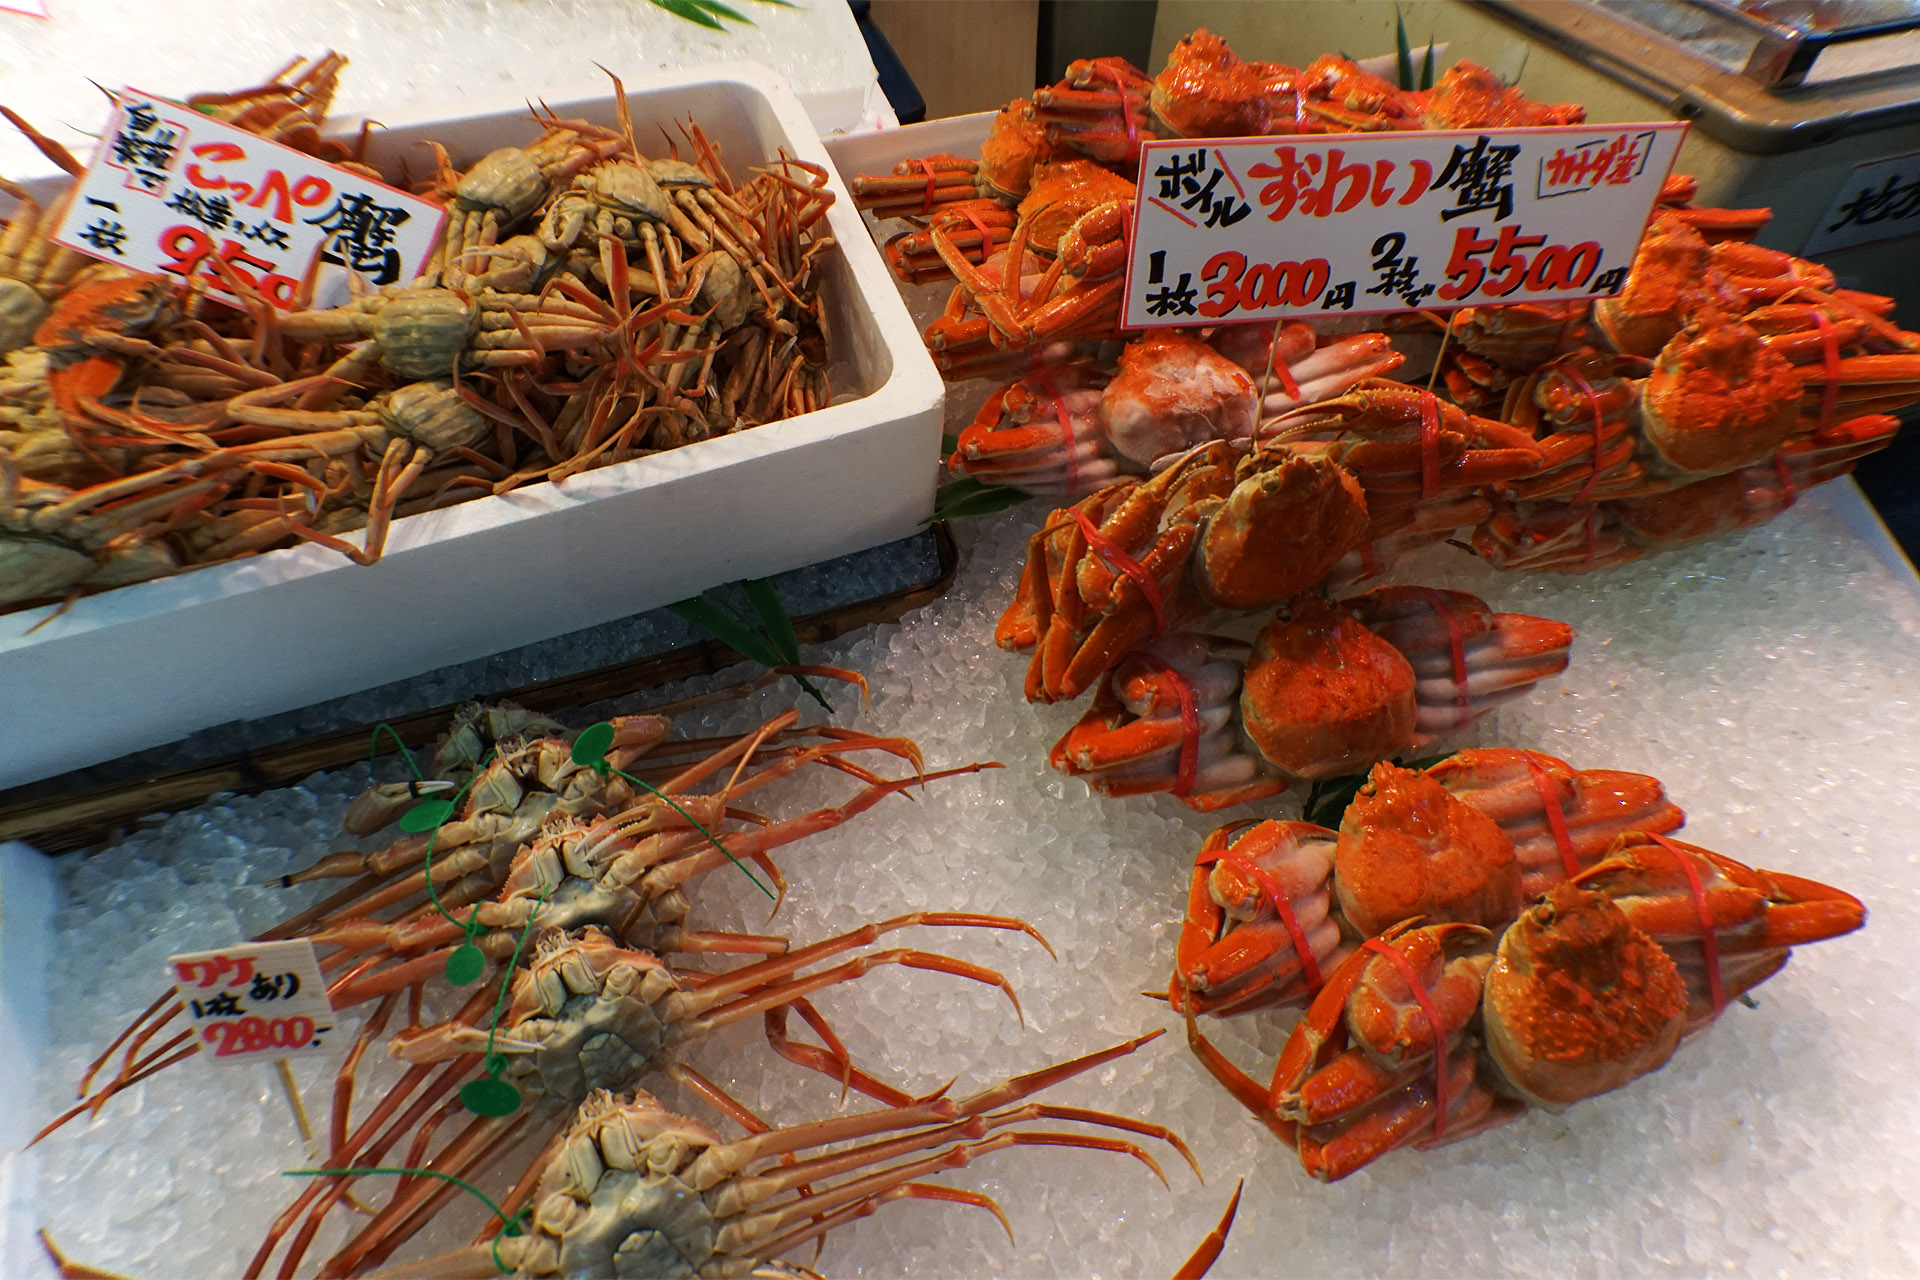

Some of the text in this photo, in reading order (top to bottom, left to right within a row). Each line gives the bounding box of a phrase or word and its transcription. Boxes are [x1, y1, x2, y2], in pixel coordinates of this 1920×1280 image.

[1154, 148, 1252, 228] ボイル
[1247, 135, 1521, 222] ずわい蟹
[1546, 134, 1642, 187] カナダ産
[78, 195, 301, 313] 一枚 950
[174, 955, 301, 1001] ワケあり
